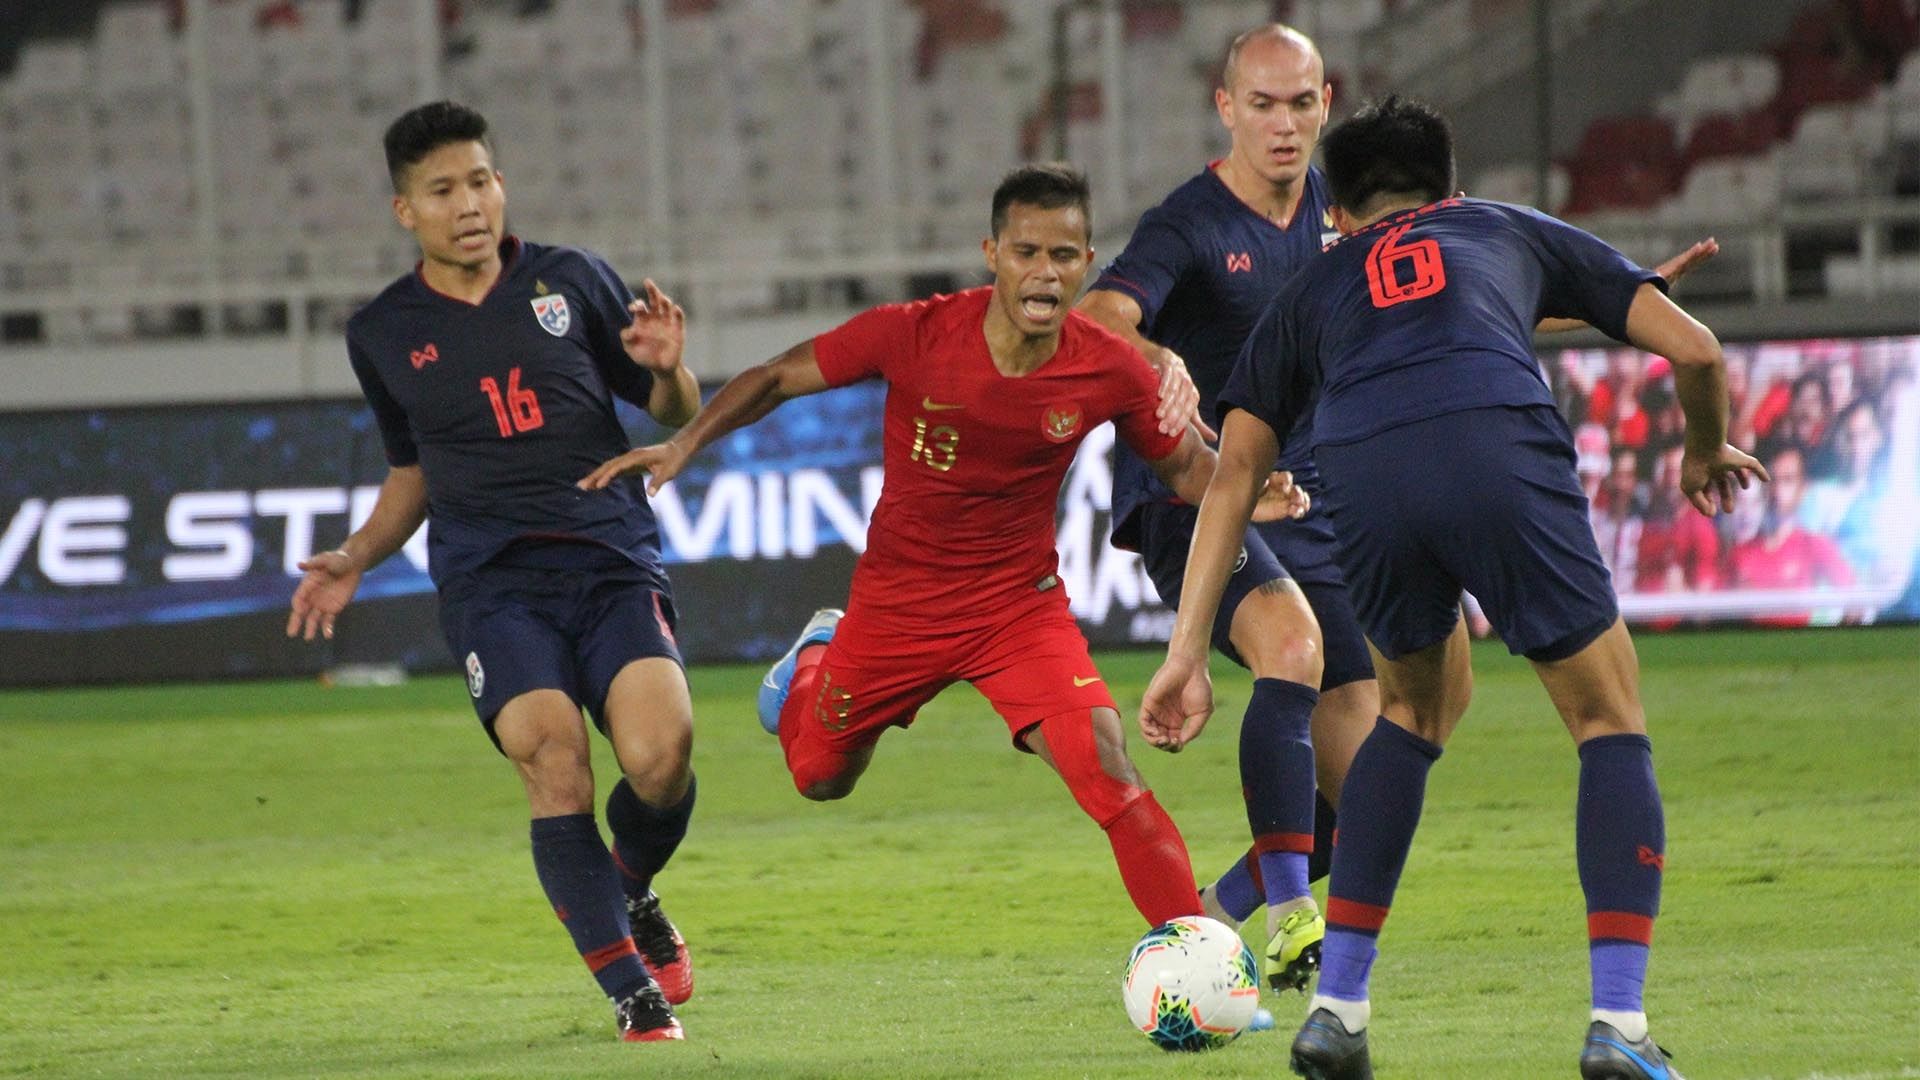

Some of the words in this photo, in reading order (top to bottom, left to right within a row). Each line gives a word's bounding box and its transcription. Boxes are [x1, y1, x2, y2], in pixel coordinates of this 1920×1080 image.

[1365, 223, 1446, 309] 6
[480, 366, 544, 438] 16
[910, 416, 960, 472] 13
